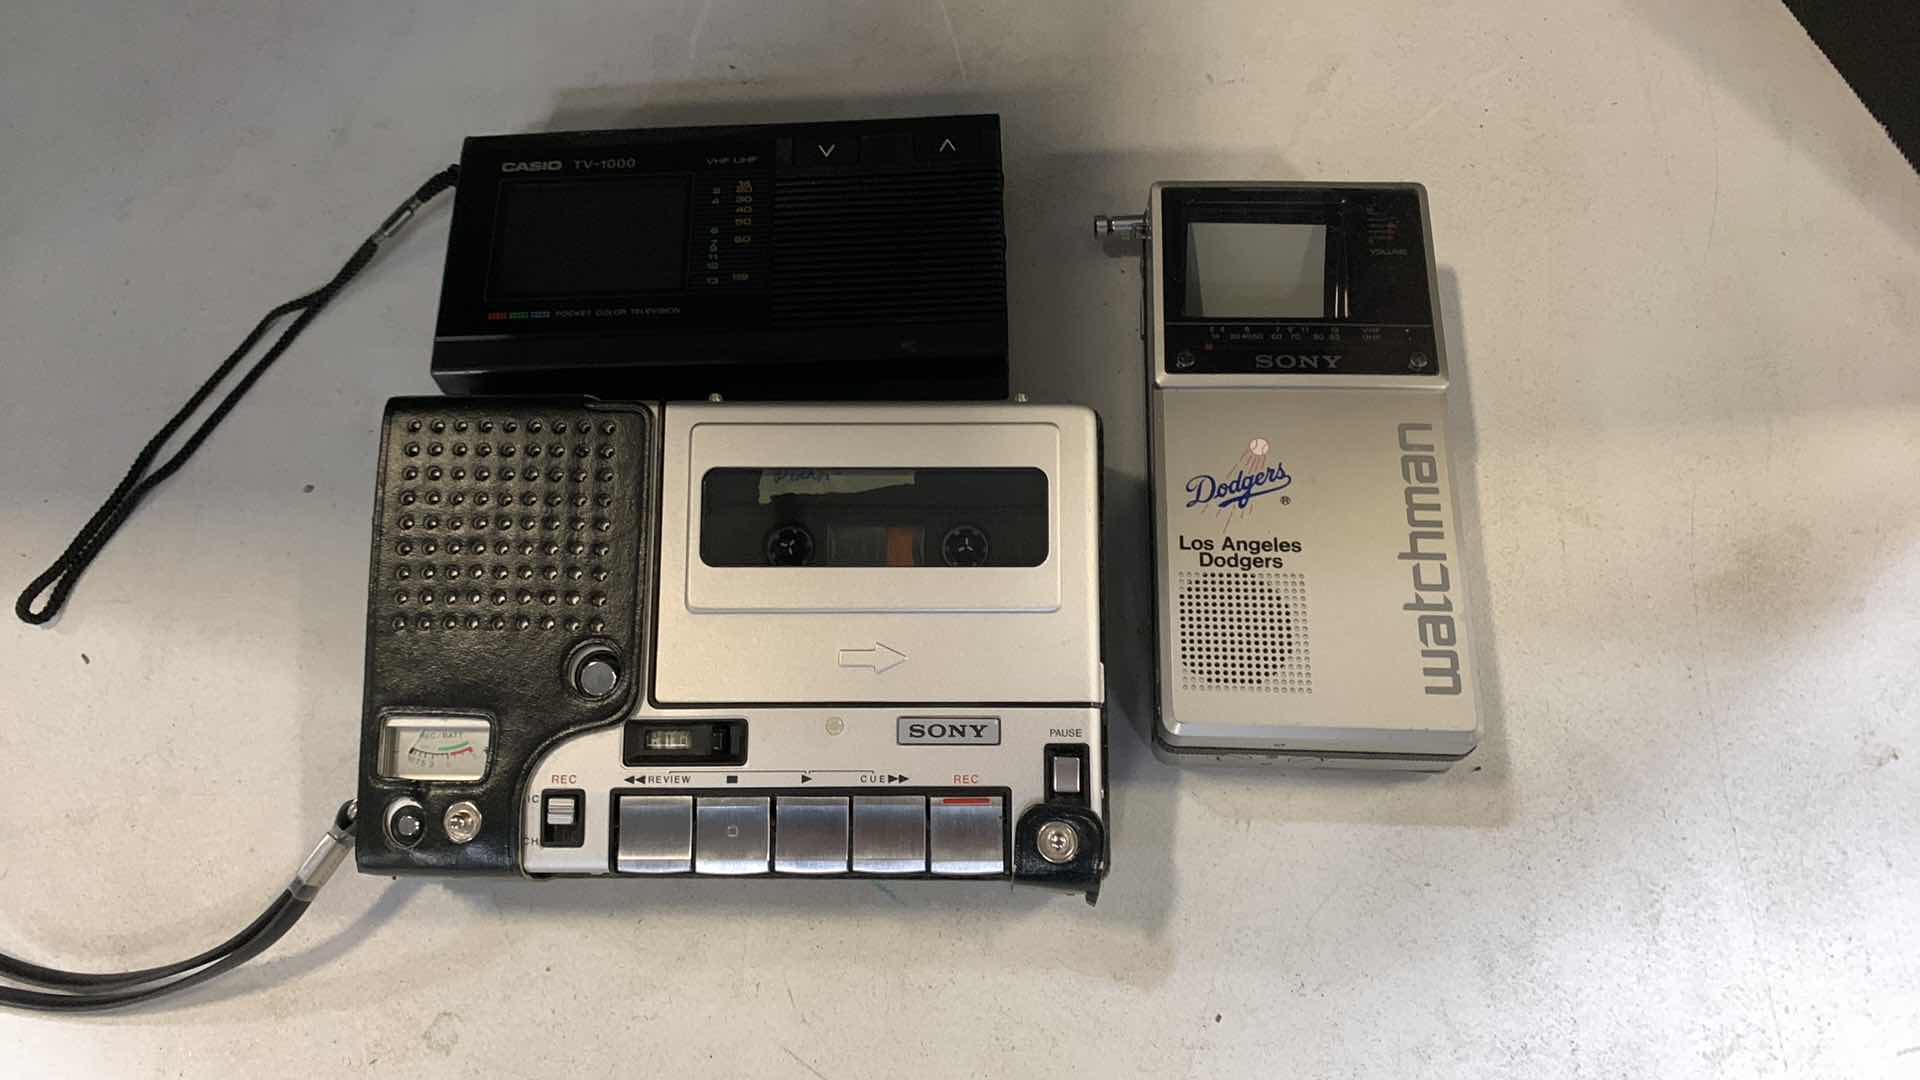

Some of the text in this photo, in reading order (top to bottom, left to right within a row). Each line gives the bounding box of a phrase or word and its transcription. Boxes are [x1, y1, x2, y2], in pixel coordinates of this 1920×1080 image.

[501, 157, 636, 172] CASIO TV-1000
[1255, 354, 1343, 369] SONY
[1185, 462, 1292, 509] Dodgers
[1179, 535, 1302, 554] Los Angeles
[1199, 552, 1283, 570] Dodgers
[1397, 423, 1462, 695] watchman
[909, 723, 988, 738] SONY
[1049, 728, 1082, 738] PAUSE
[551, 774, 577, 785] REC
[648, 775, 691, 784] REVIEW
[860, 775, 885, 784] CUE
[953, 774, 979, 785] REC
